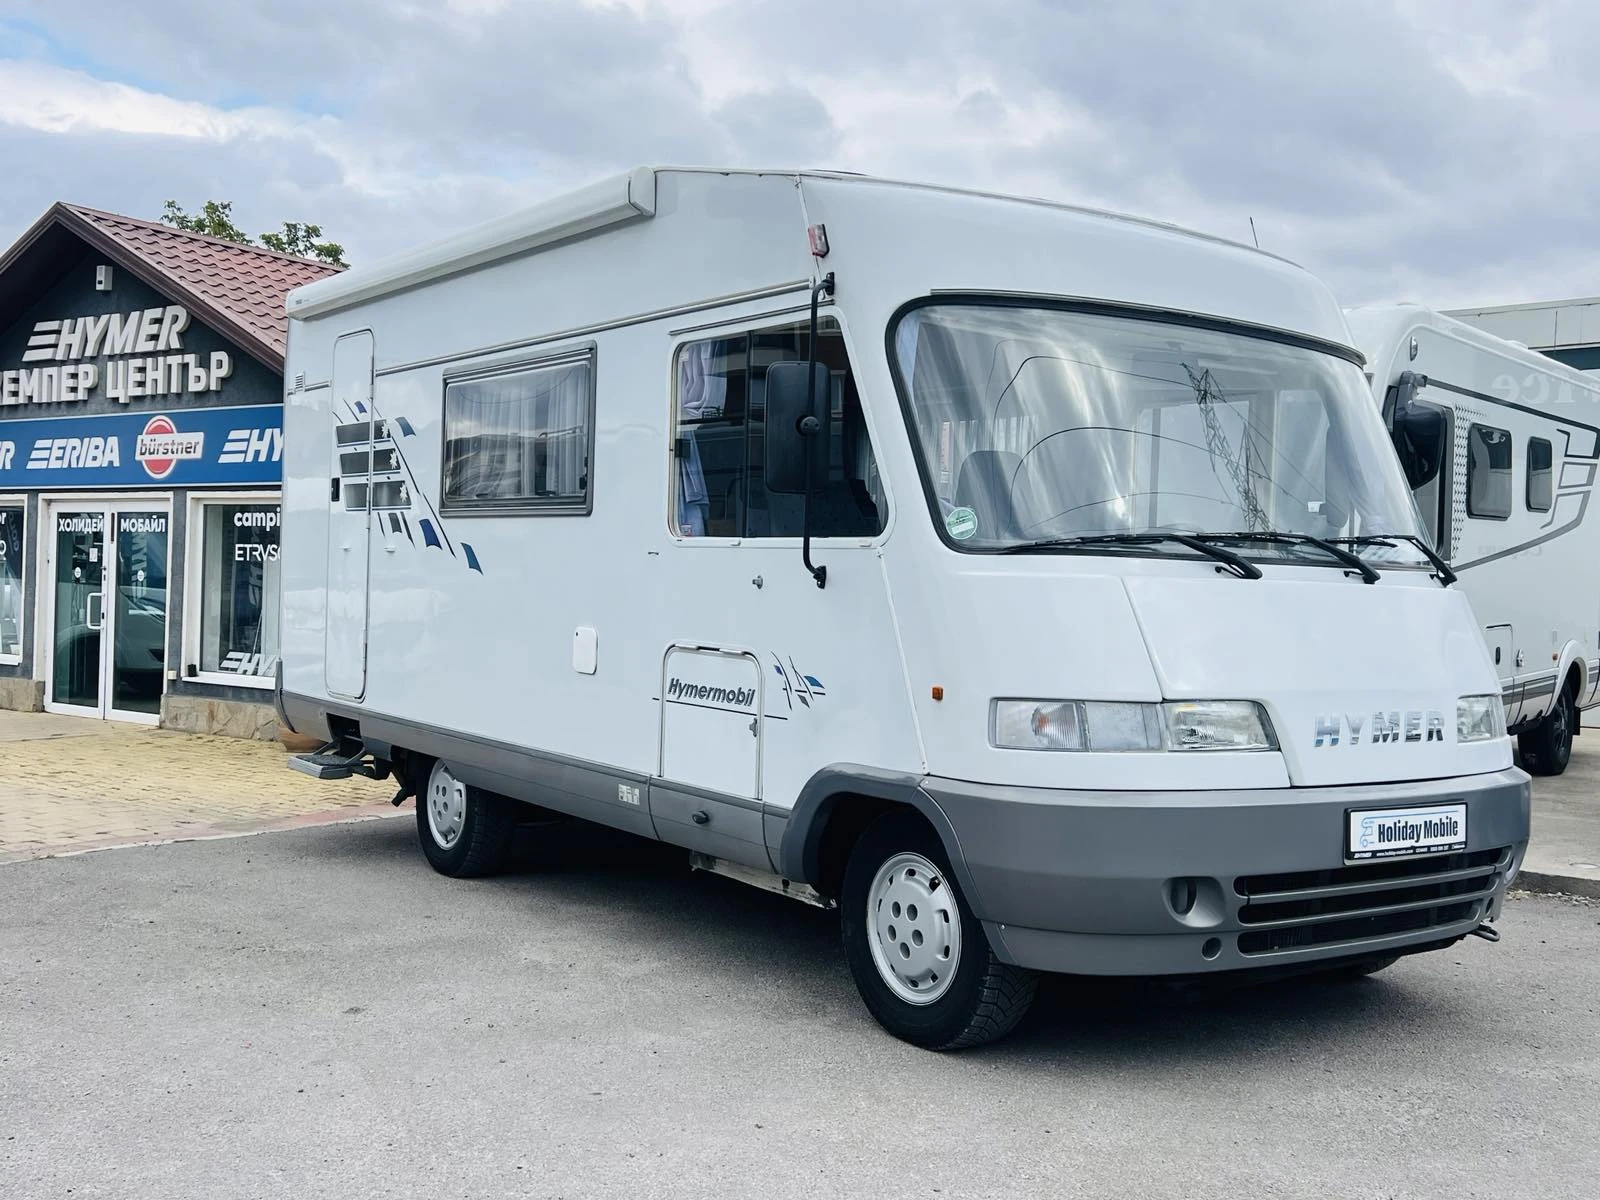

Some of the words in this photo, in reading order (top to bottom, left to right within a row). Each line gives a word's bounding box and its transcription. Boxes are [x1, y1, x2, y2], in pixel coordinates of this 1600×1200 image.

[55, 305, 190, 361] HYMER
[0, 363, 98, 405] ЕМПЕР
[106, 350, 233, 403] ЦЕНТЪР
[48, 436, 120, 468] ERIBA
[139, 438, 200, 456] bürstner
[58, 515, 104, 534] ХОЛИДЕЙ
[120, 515, 166, 532] МОБАЙЛ
[234, 506, 281, 532] campi
[667, 677, 756, 706] Hymermobil
[1313, 711, 1446, 747] HYMER
[1378, 819, 1422, 843] Holiday
[1424, 815, 1458, 839] Mobile
